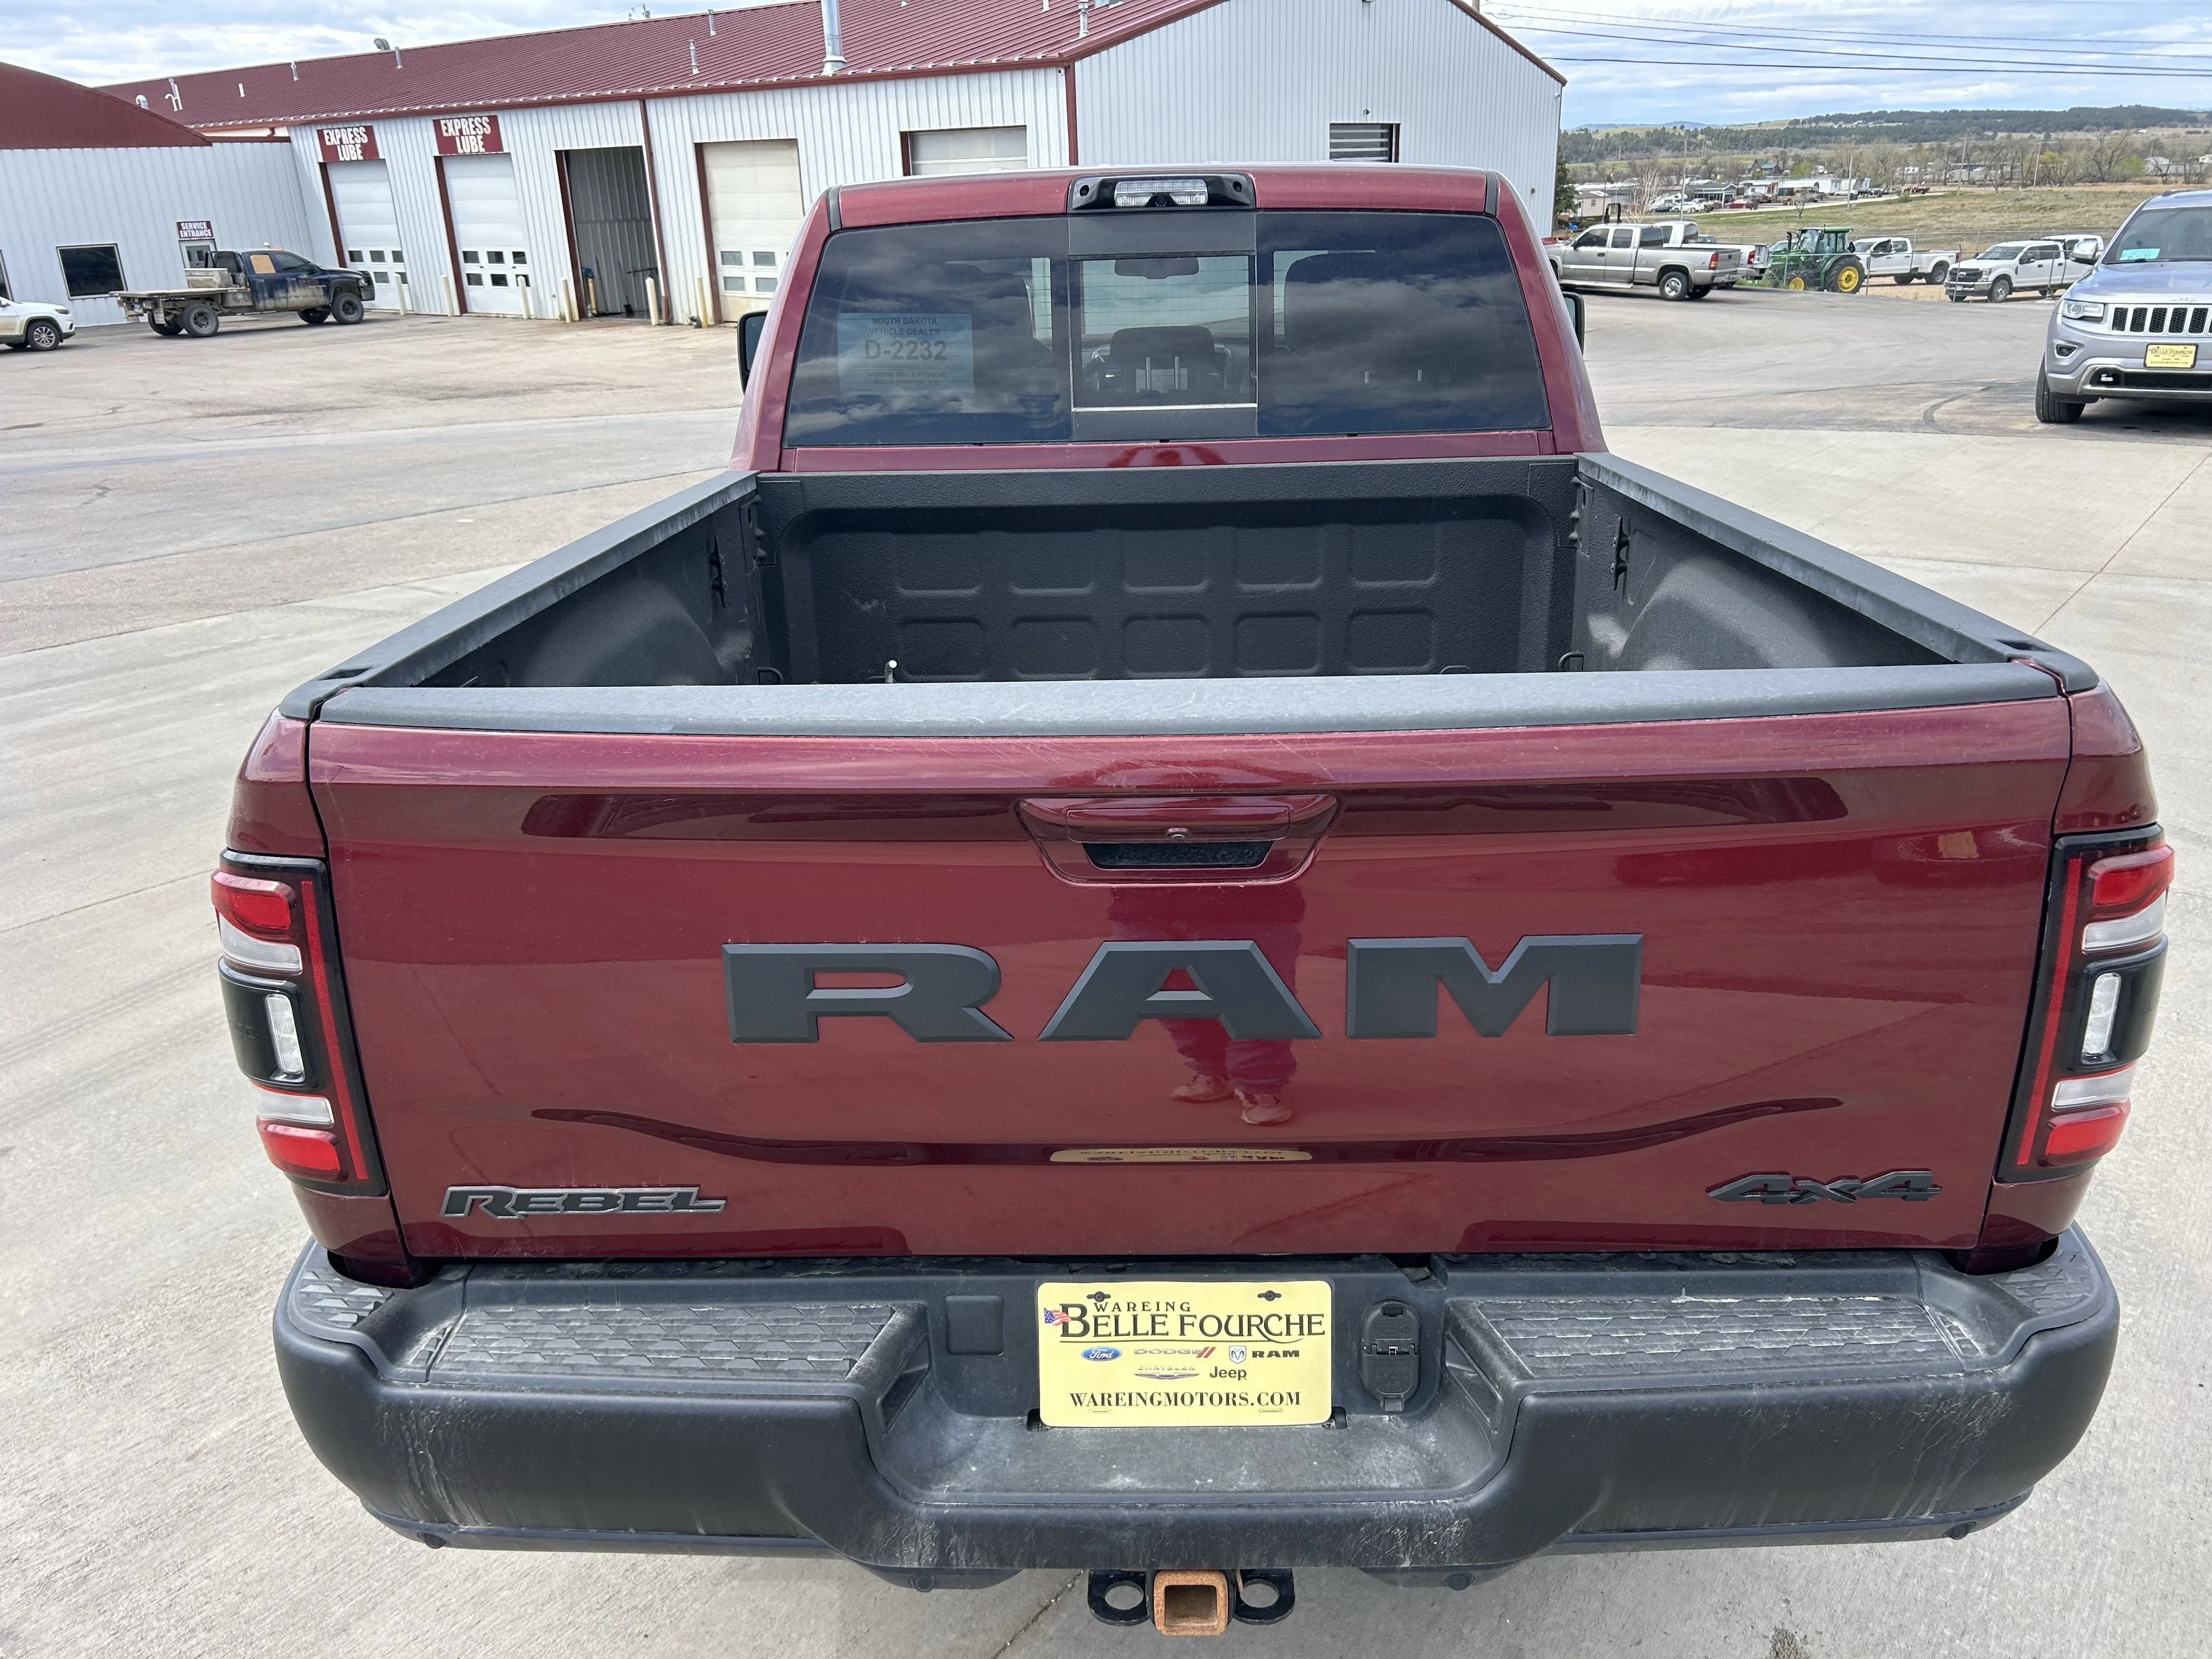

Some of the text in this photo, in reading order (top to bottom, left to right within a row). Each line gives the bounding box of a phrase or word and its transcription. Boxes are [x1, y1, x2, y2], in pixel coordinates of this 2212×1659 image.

[440, 117, 492, 137] EXPRESS
[323, 127, 368, 145] EXPRESS
[455, 135, 486, 153] LUBE
[337, 144, 364, 161] LUBE
[179, 229, 212, 238] ENTRANCE
[180, 222, 208, 230] SERVICE
[865, 340, 947, 360] D-2232
[722, 933, 1644, 1044] RAM
[440, 1185, 726, 1219] REBEL
[1093, 1301, 1190, 1312] WAREING
[1059, 1303, 1325, 1344] BELLE FOURCHE
[1089, 1348, 1114, 1359] Ford
[1252, 1350, 1300, 1358] RAM
[1210, 1366, 1248, 1380] Jeep
[1069, 1391, 1301, 1407] WAREINGMOTORS.COM
